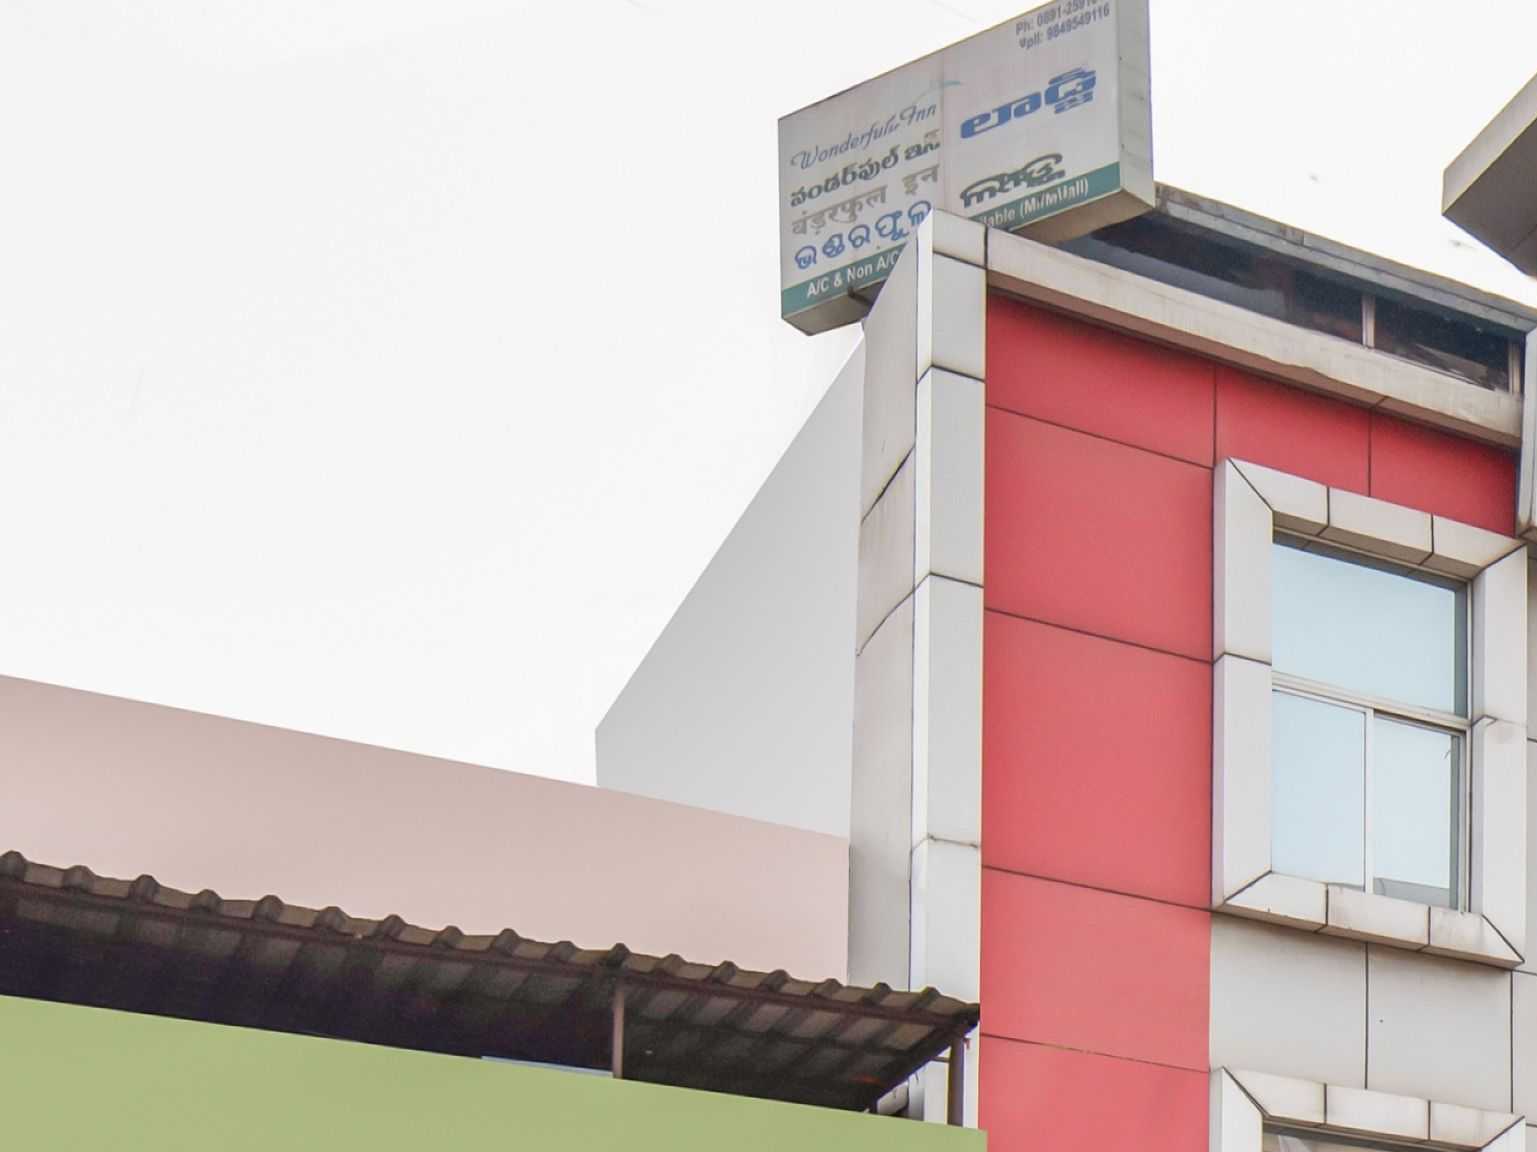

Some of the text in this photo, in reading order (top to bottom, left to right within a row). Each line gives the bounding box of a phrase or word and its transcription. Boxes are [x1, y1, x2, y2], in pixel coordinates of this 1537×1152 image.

[807, 280, 830, 298] A/C
[834, 274, 843, 288] &
[847, 263, 873, 282] Non
